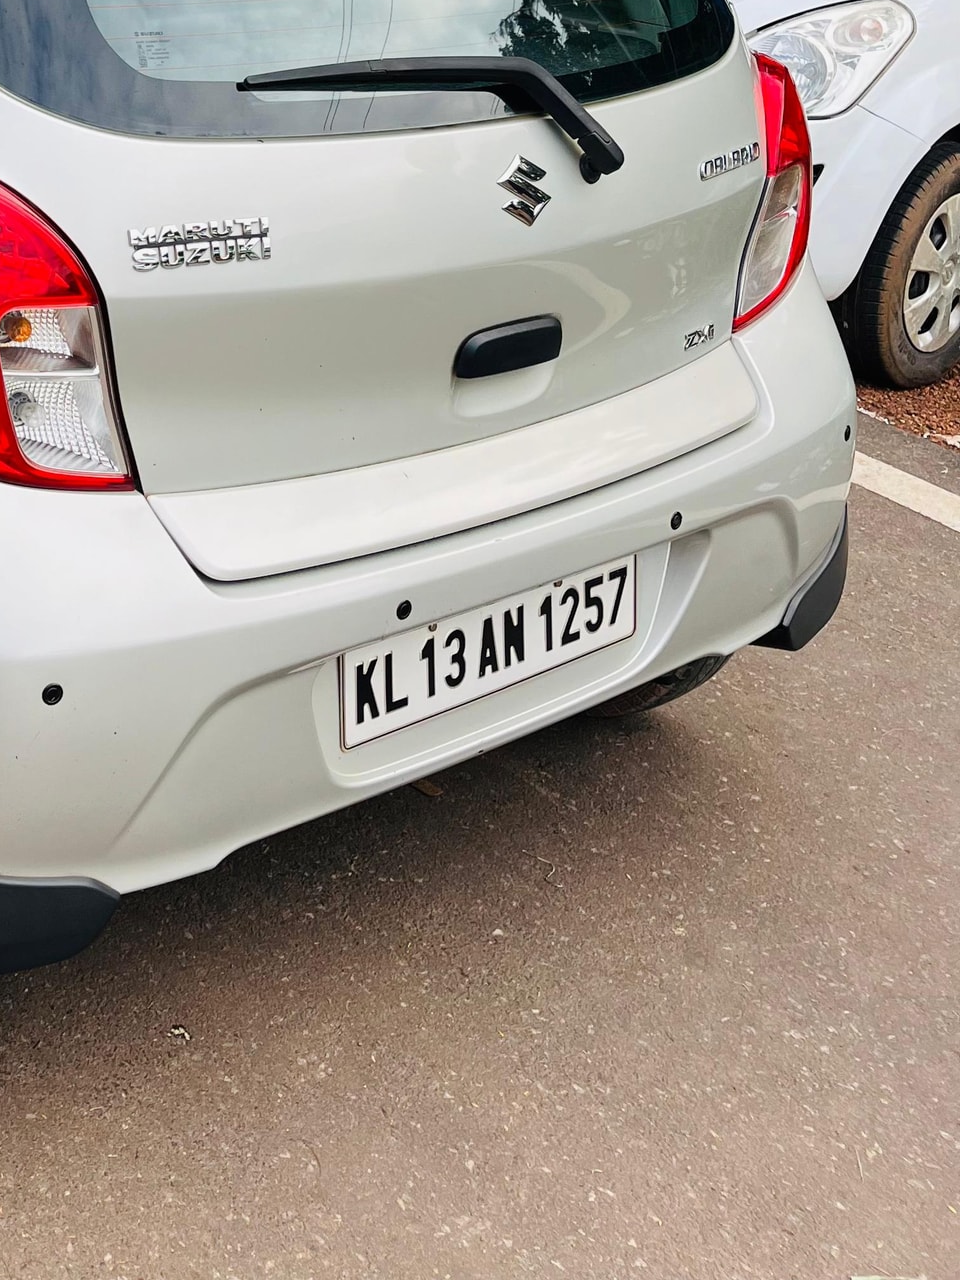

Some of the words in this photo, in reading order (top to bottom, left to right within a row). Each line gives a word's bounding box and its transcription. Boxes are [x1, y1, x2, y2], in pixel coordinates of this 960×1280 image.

[127, 216, 270, 247] MARUTI
[131, 237, 272, 273] SUZUKI
[355, 649, 409, 725] KL
[419, 628, 467, 699] 13
[478, 602, 526, 680] AN
[538, 564, 628, 653] 1257
